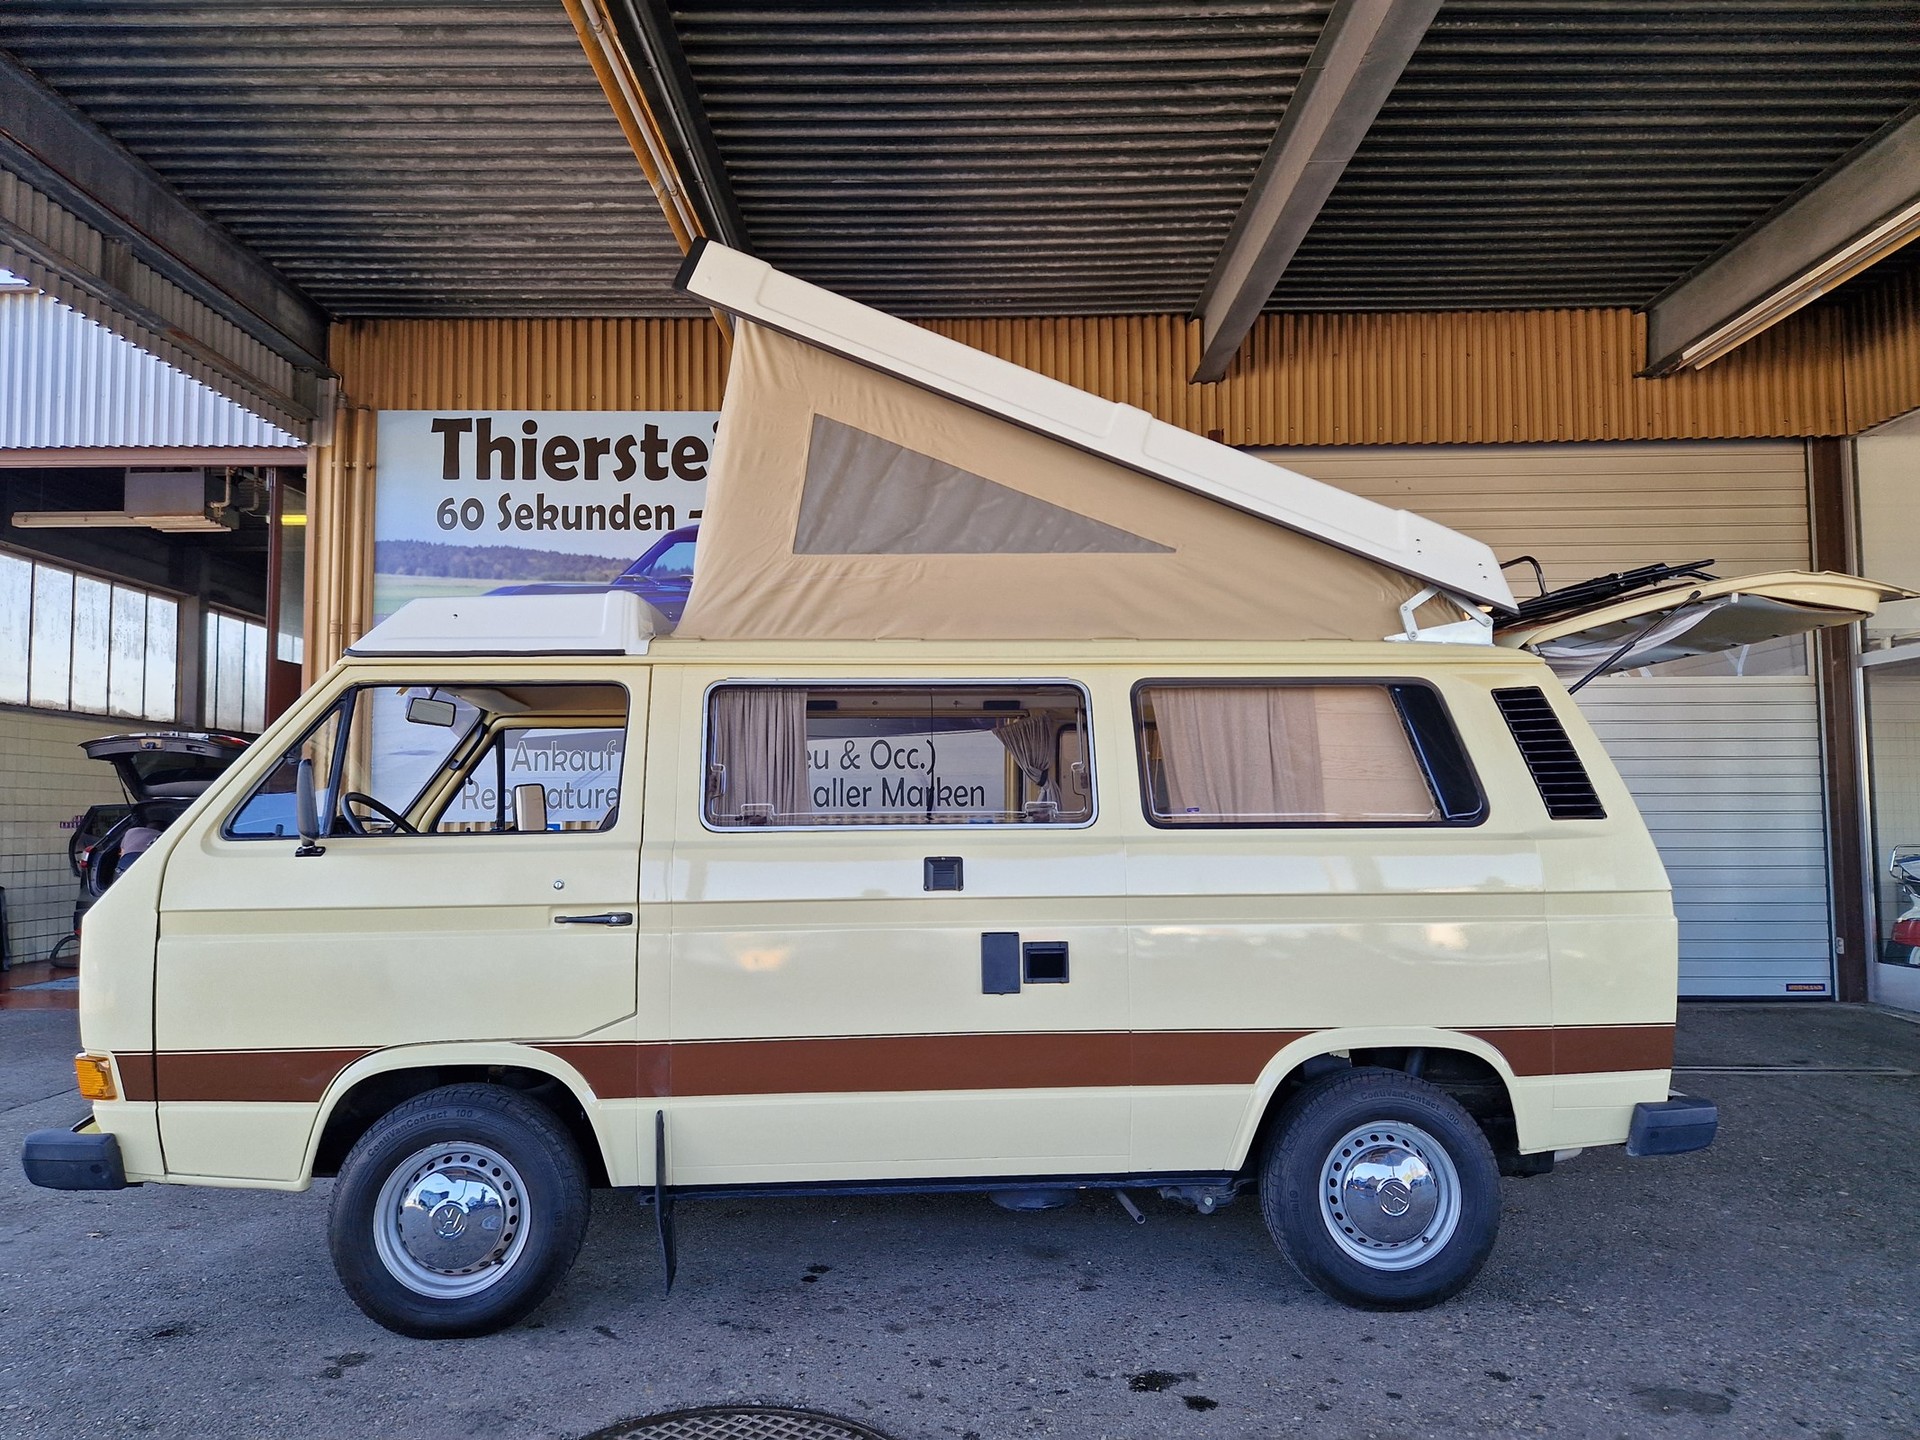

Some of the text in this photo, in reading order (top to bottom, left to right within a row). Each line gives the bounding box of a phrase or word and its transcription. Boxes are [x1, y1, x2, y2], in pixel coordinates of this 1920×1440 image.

[431, 417, 718, 482] Thierste
[436, 497, 485, 531] 60
[497, 493, 675, 531] Sekunden
[511, 739, 616, 772] Ankauf
[840, 740, 861, 770] &
[870, 739, 936, 775] Occ.)
[461, 777, 985, 811] Reature aller Marken
[1361, 1090, 1441, 1112] ContiVanContact
[367, 1109, 473, 1156] ContiVanContact 100
